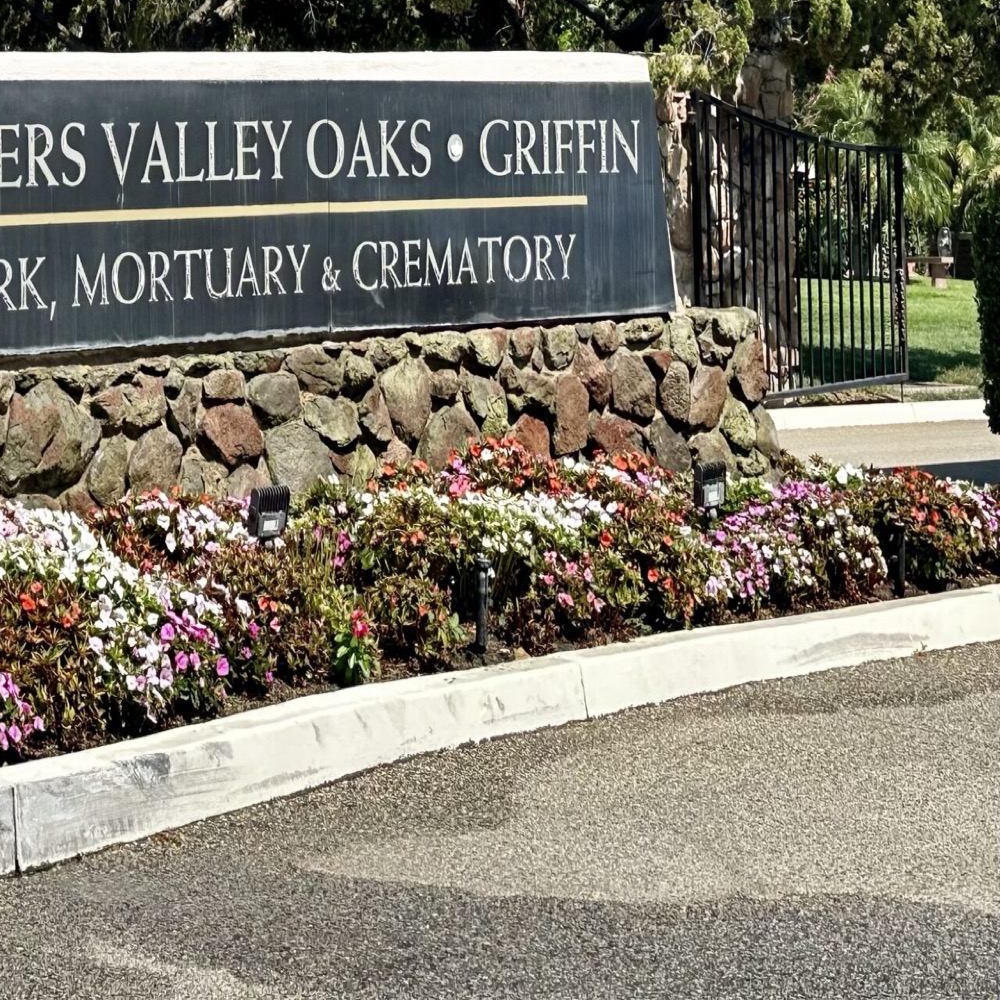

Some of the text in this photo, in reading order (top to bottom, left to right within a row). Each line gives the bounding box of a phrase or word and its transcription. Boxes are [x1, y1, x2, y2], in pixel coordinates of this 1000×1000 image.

[100, 118, 293, 187] VALLEY
[306, 118, 432, 179] OAKS
[479, 118, 641, 177] GRIFFIN
[71, 243, 311, 308] MORTUARY
[321, 256, 342, 292] &
[352, 233, 577, 291] CREMATORY
